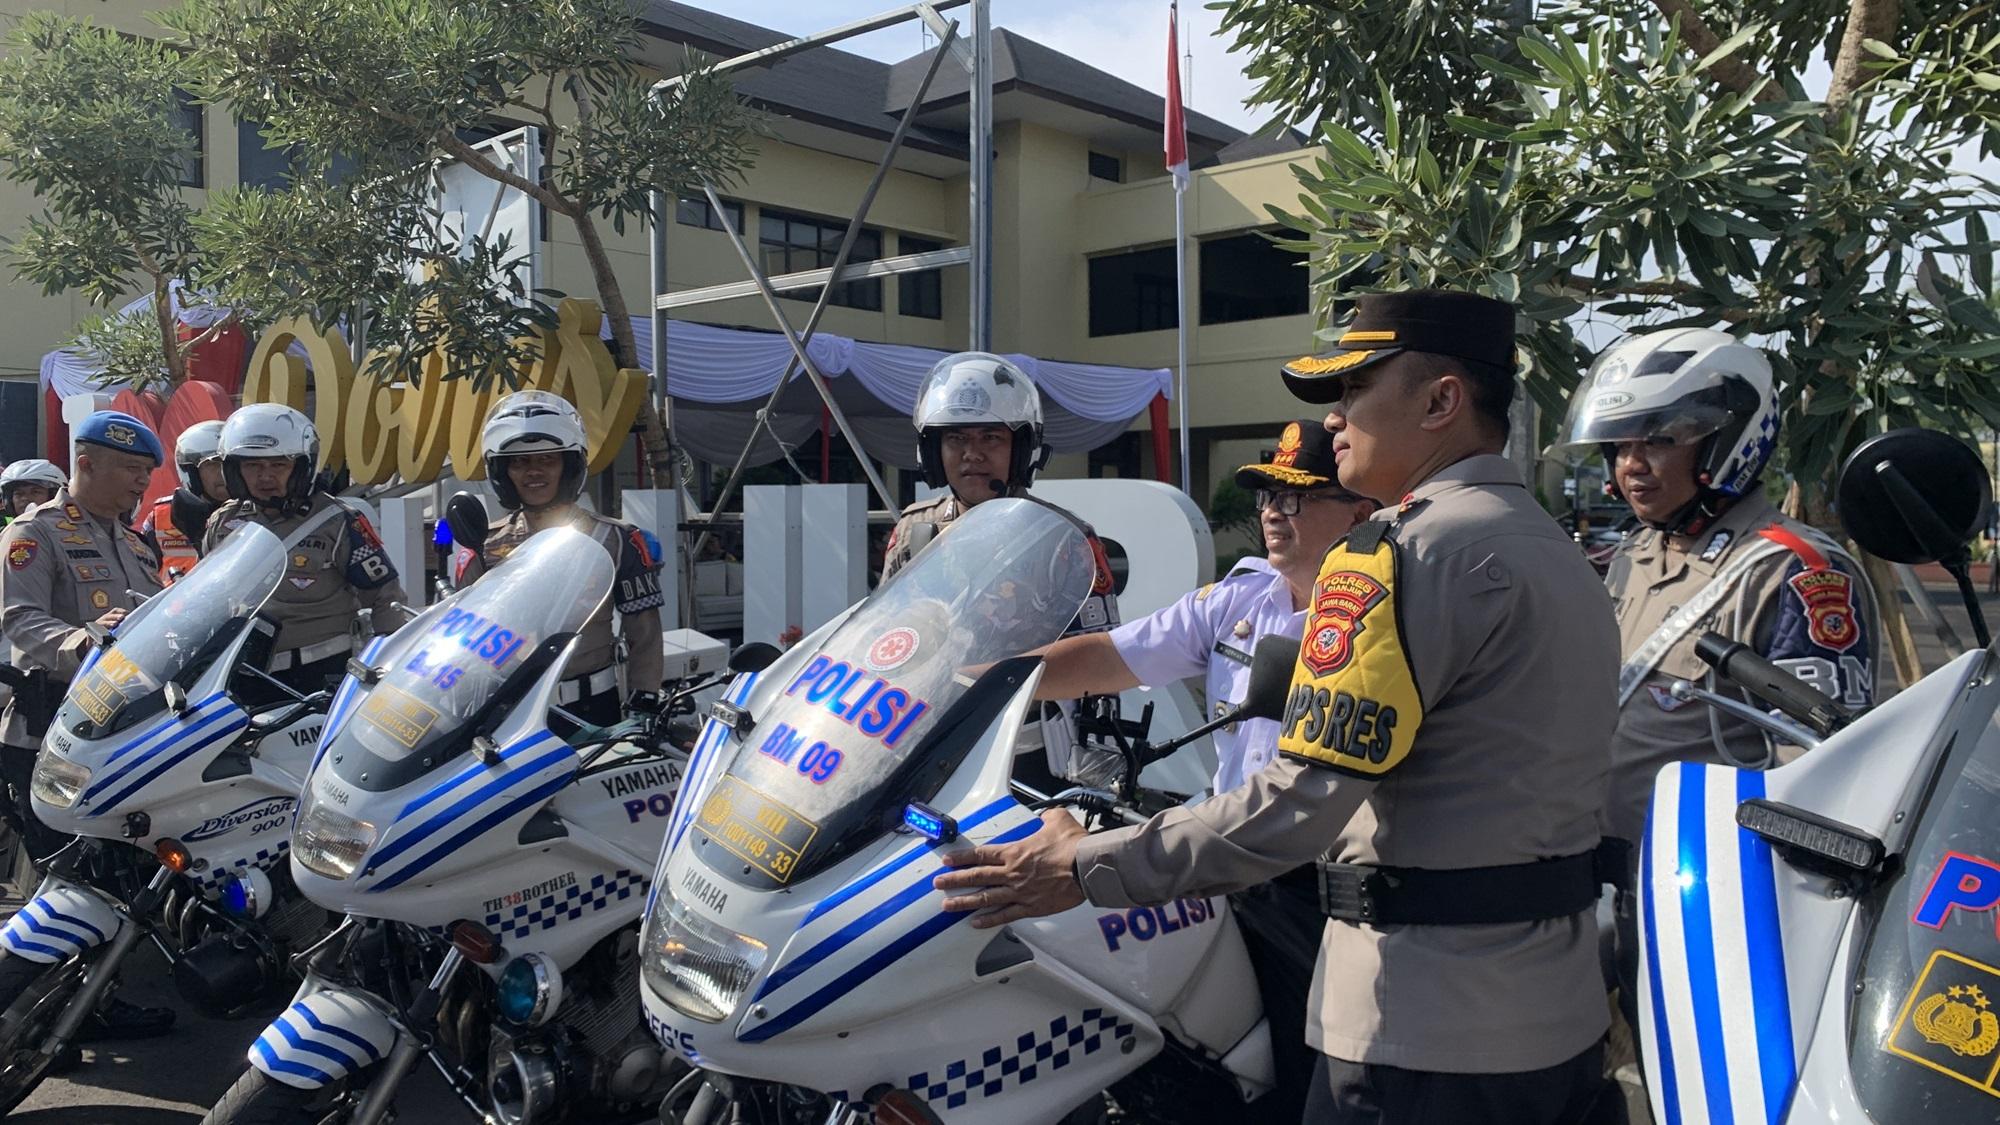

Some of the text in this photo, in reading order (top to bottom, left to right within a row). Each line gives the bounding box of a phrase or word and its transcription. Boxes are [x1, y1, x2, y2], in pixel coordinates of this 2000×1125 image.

[298, 538, 327, 550] OLRI
[1323, 575, 1373, 594] POLRES
[433, 607, 525, 669] POLISI
[785, 655, 929, 749] POLISI
[758, 722, 845, 785] BM 09
[602, 763, 682, 799] YAMAHA
[199, 801, 292, 834] Diversion
[250, 816, 286, 836] 900
[483, 871, 576, 914] TH38ROTHER
[681, 867, 729, 915] YAMAHA
[1098, 894, 1216, 952] POLISI
